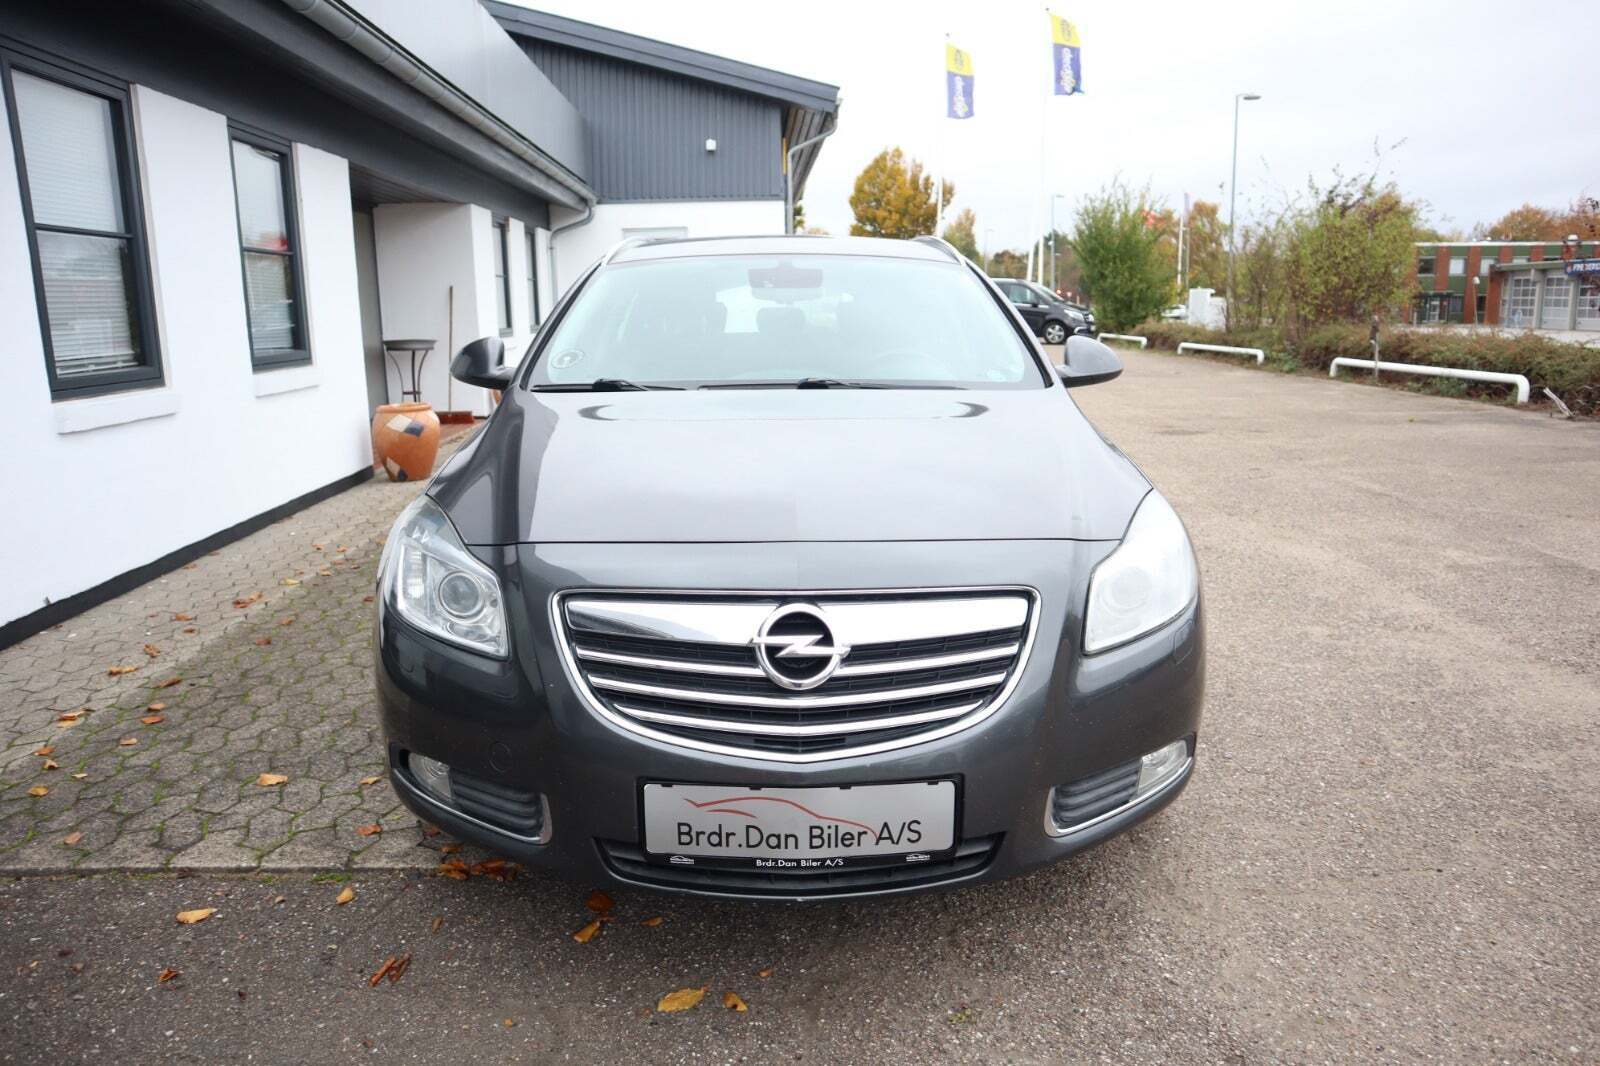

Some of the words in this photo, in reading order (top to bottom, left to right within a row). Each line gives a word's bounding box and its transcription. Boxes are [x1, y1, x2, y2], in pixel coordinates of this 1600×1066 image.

[677, 822, 799, 850] Brdr.Dan
[808, 825, 868, 850] Biler
[876, 819, 922, 845] A/S
[756, 859, 797, 867] Brdr.Dan
[800, 859, 822, 867] Biler
[825, 858, 844, 867] A/S
